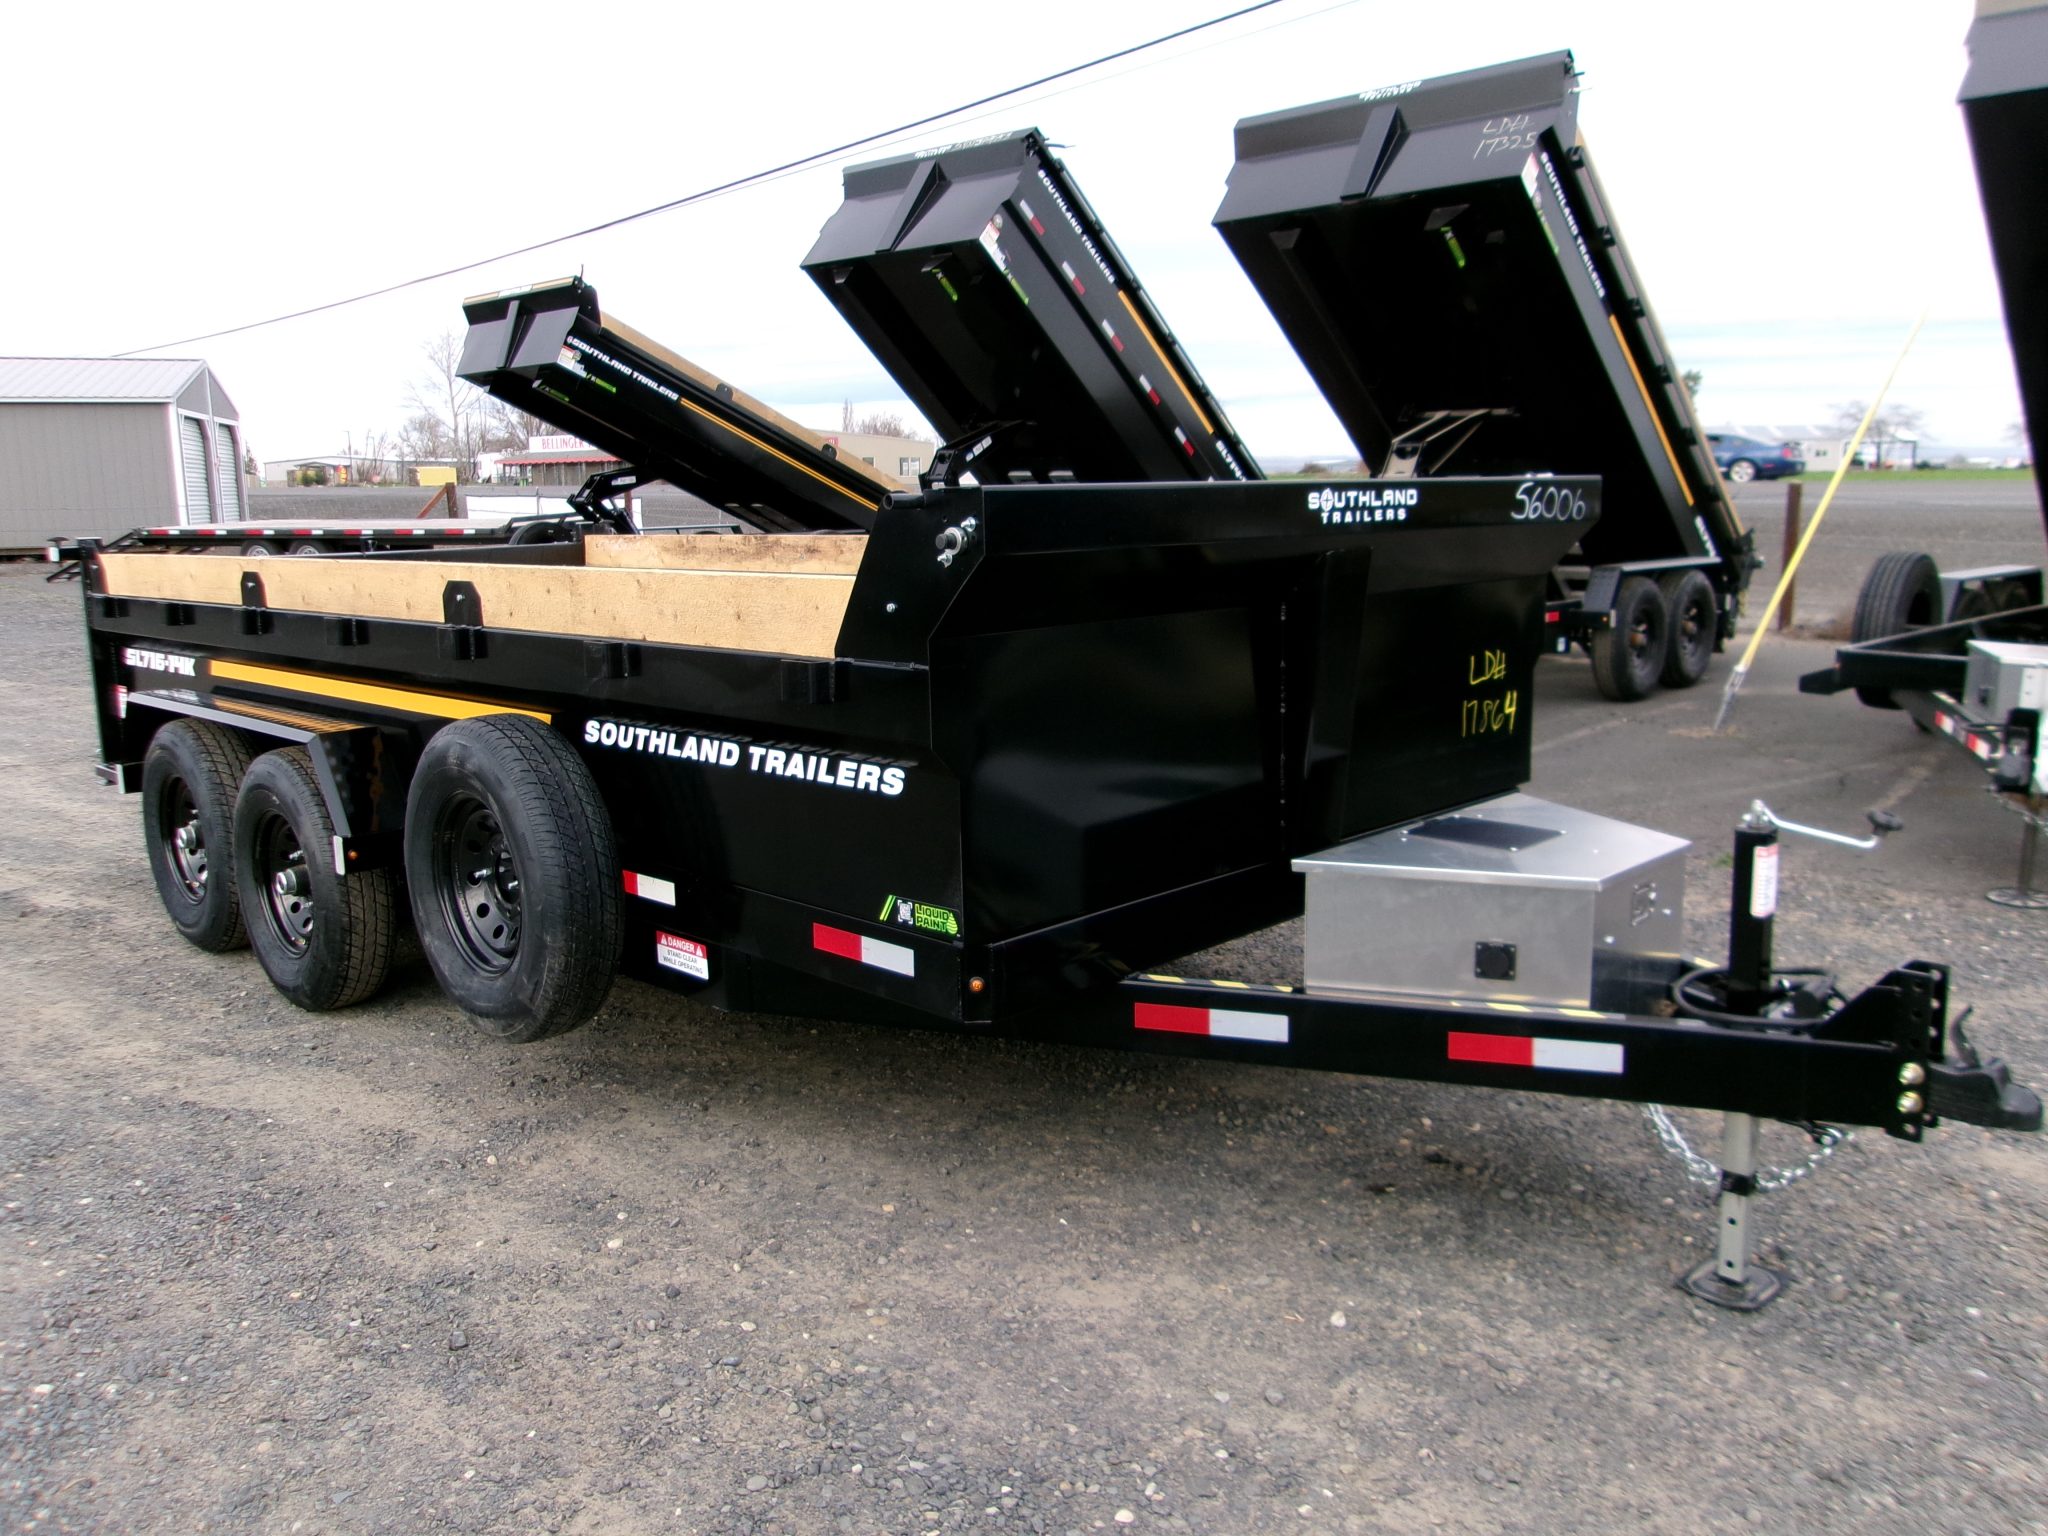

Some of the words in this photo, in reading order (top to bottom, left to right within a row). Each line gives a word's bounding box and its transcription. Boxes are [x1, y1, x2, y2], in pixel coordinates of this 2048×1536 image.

[1037, 169, 1083, 235] SOUTHLAND
[1081, 234, 1115, 284] TRAILERS
[1540, 151, 1579, 236] SOUTHLAND
[1576, 235, 1606, 298] TRAILERS
[572, 338, 633, 377] SOUTHLAND
[631, 370, 680, 401] TRAILERS
[541, 436, 585, 450] BELLINGER
[1307, 488, 1418, 512] SOUTHLAND
[1510, 482, 1586, 521] 56006
[1321, 508, 1406, 524] TRAILERS
[123, 647, 197, 677] SL716-14K
[584, 719, 740, 767] SOUTHLAND
[749, 746, 907, 796] TRAILERS
[914, 903, 950, 921] LIQUID
[915, 914, 948, 932] PAINT
[667, 936, 695, 954] DANGER
